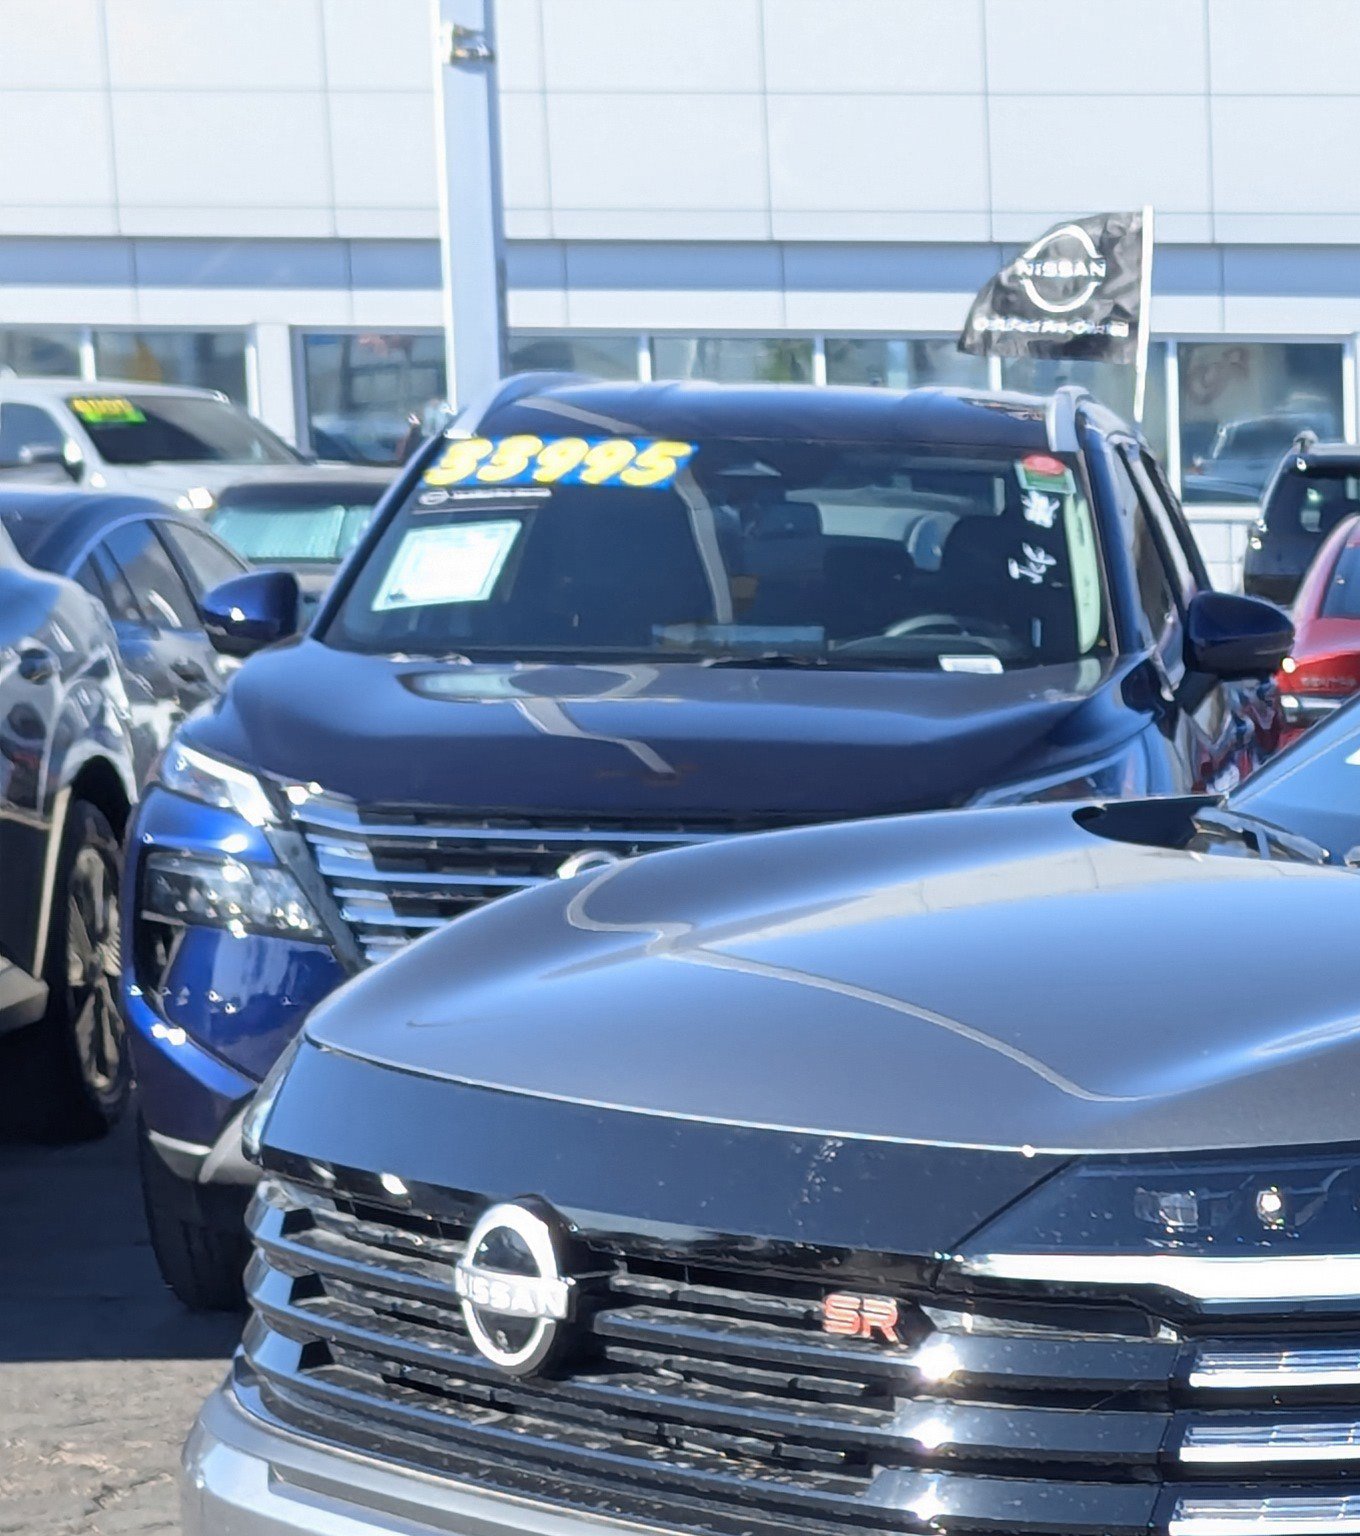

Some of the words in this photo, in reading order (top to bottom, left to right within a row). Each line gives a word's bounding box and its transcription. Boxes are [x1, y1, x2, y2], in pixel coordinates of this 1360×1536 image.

[1014, 259, 1107, 278] NISSAN
[423, 435, 692, 486] 33995
[454, 1266, 570, 1319] NISSAN
[822, 1292, 900, 1344] SR
